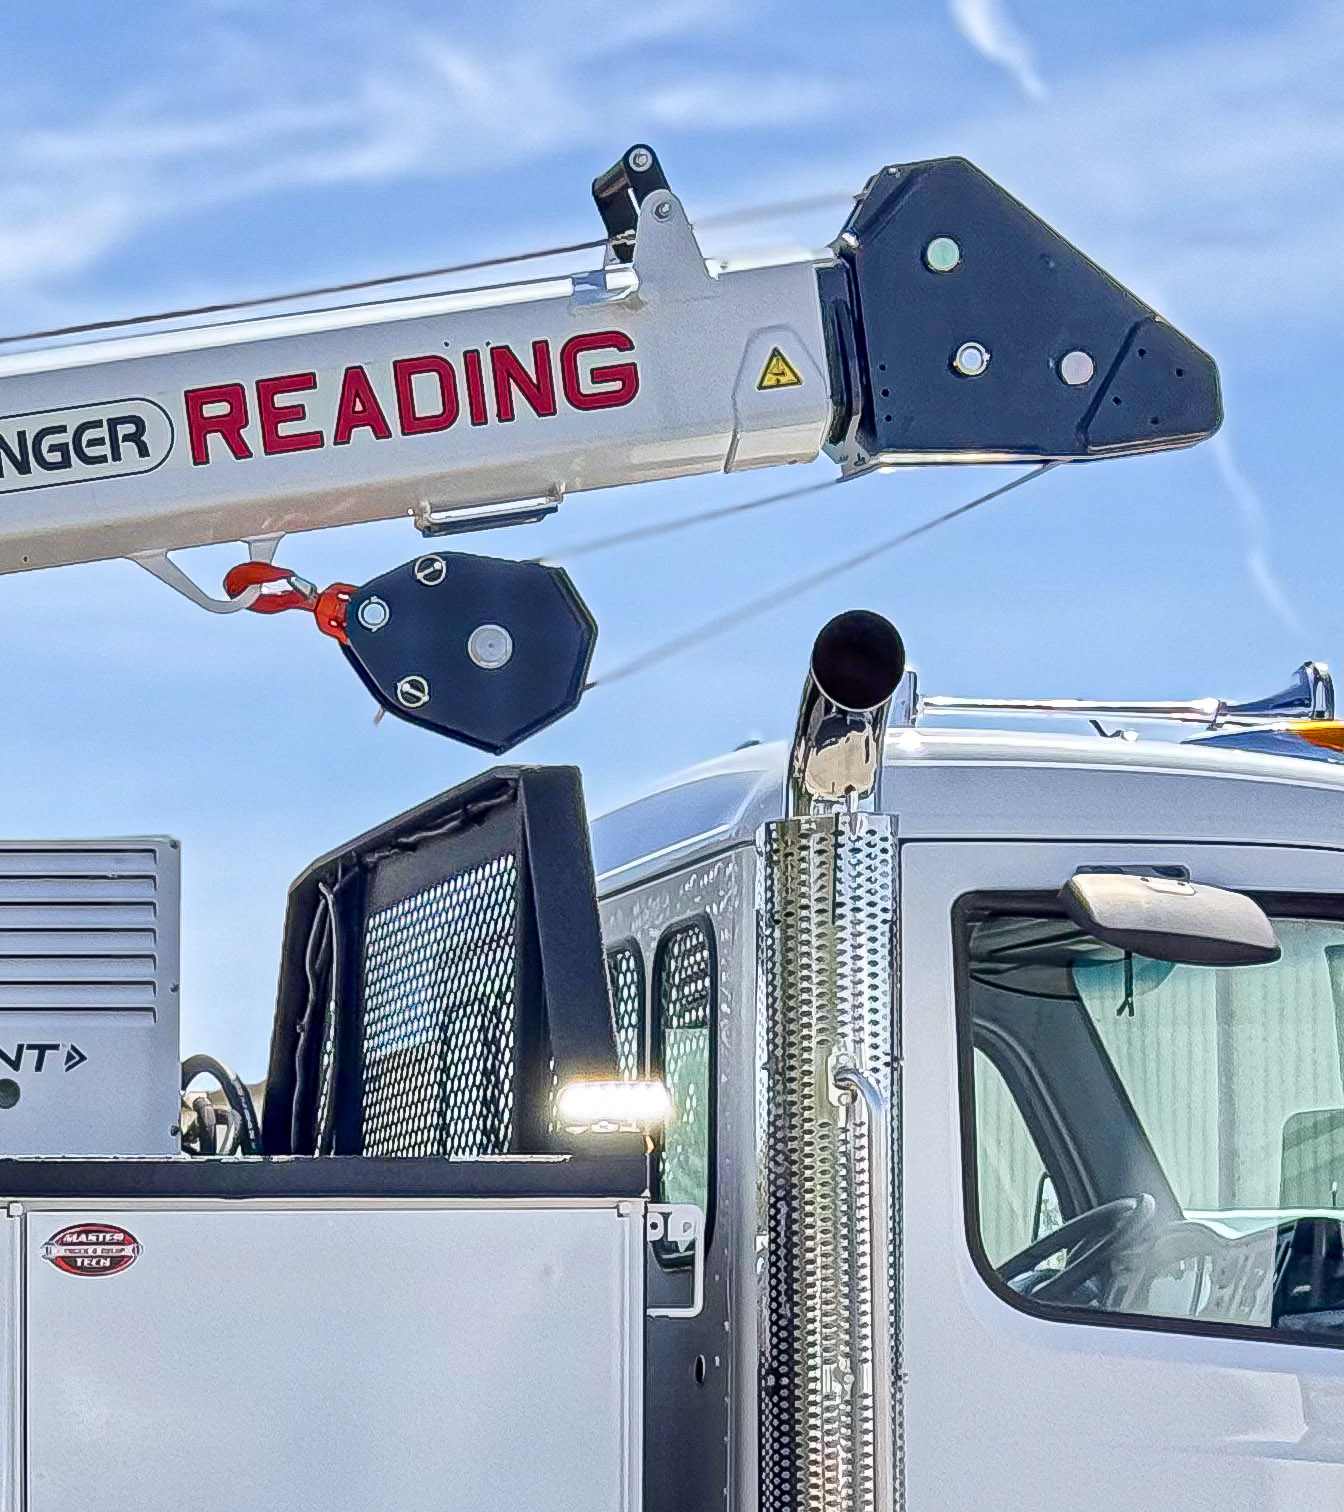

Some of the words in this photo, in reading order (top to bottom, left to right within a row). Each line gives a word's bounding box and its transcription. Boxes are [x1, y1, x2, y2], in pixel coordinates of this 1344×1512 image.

[184, 329, 640, 466] READING
[63, 1232, 124, 1243] MASTER
[75, 1257, 111, 1267] TECH
